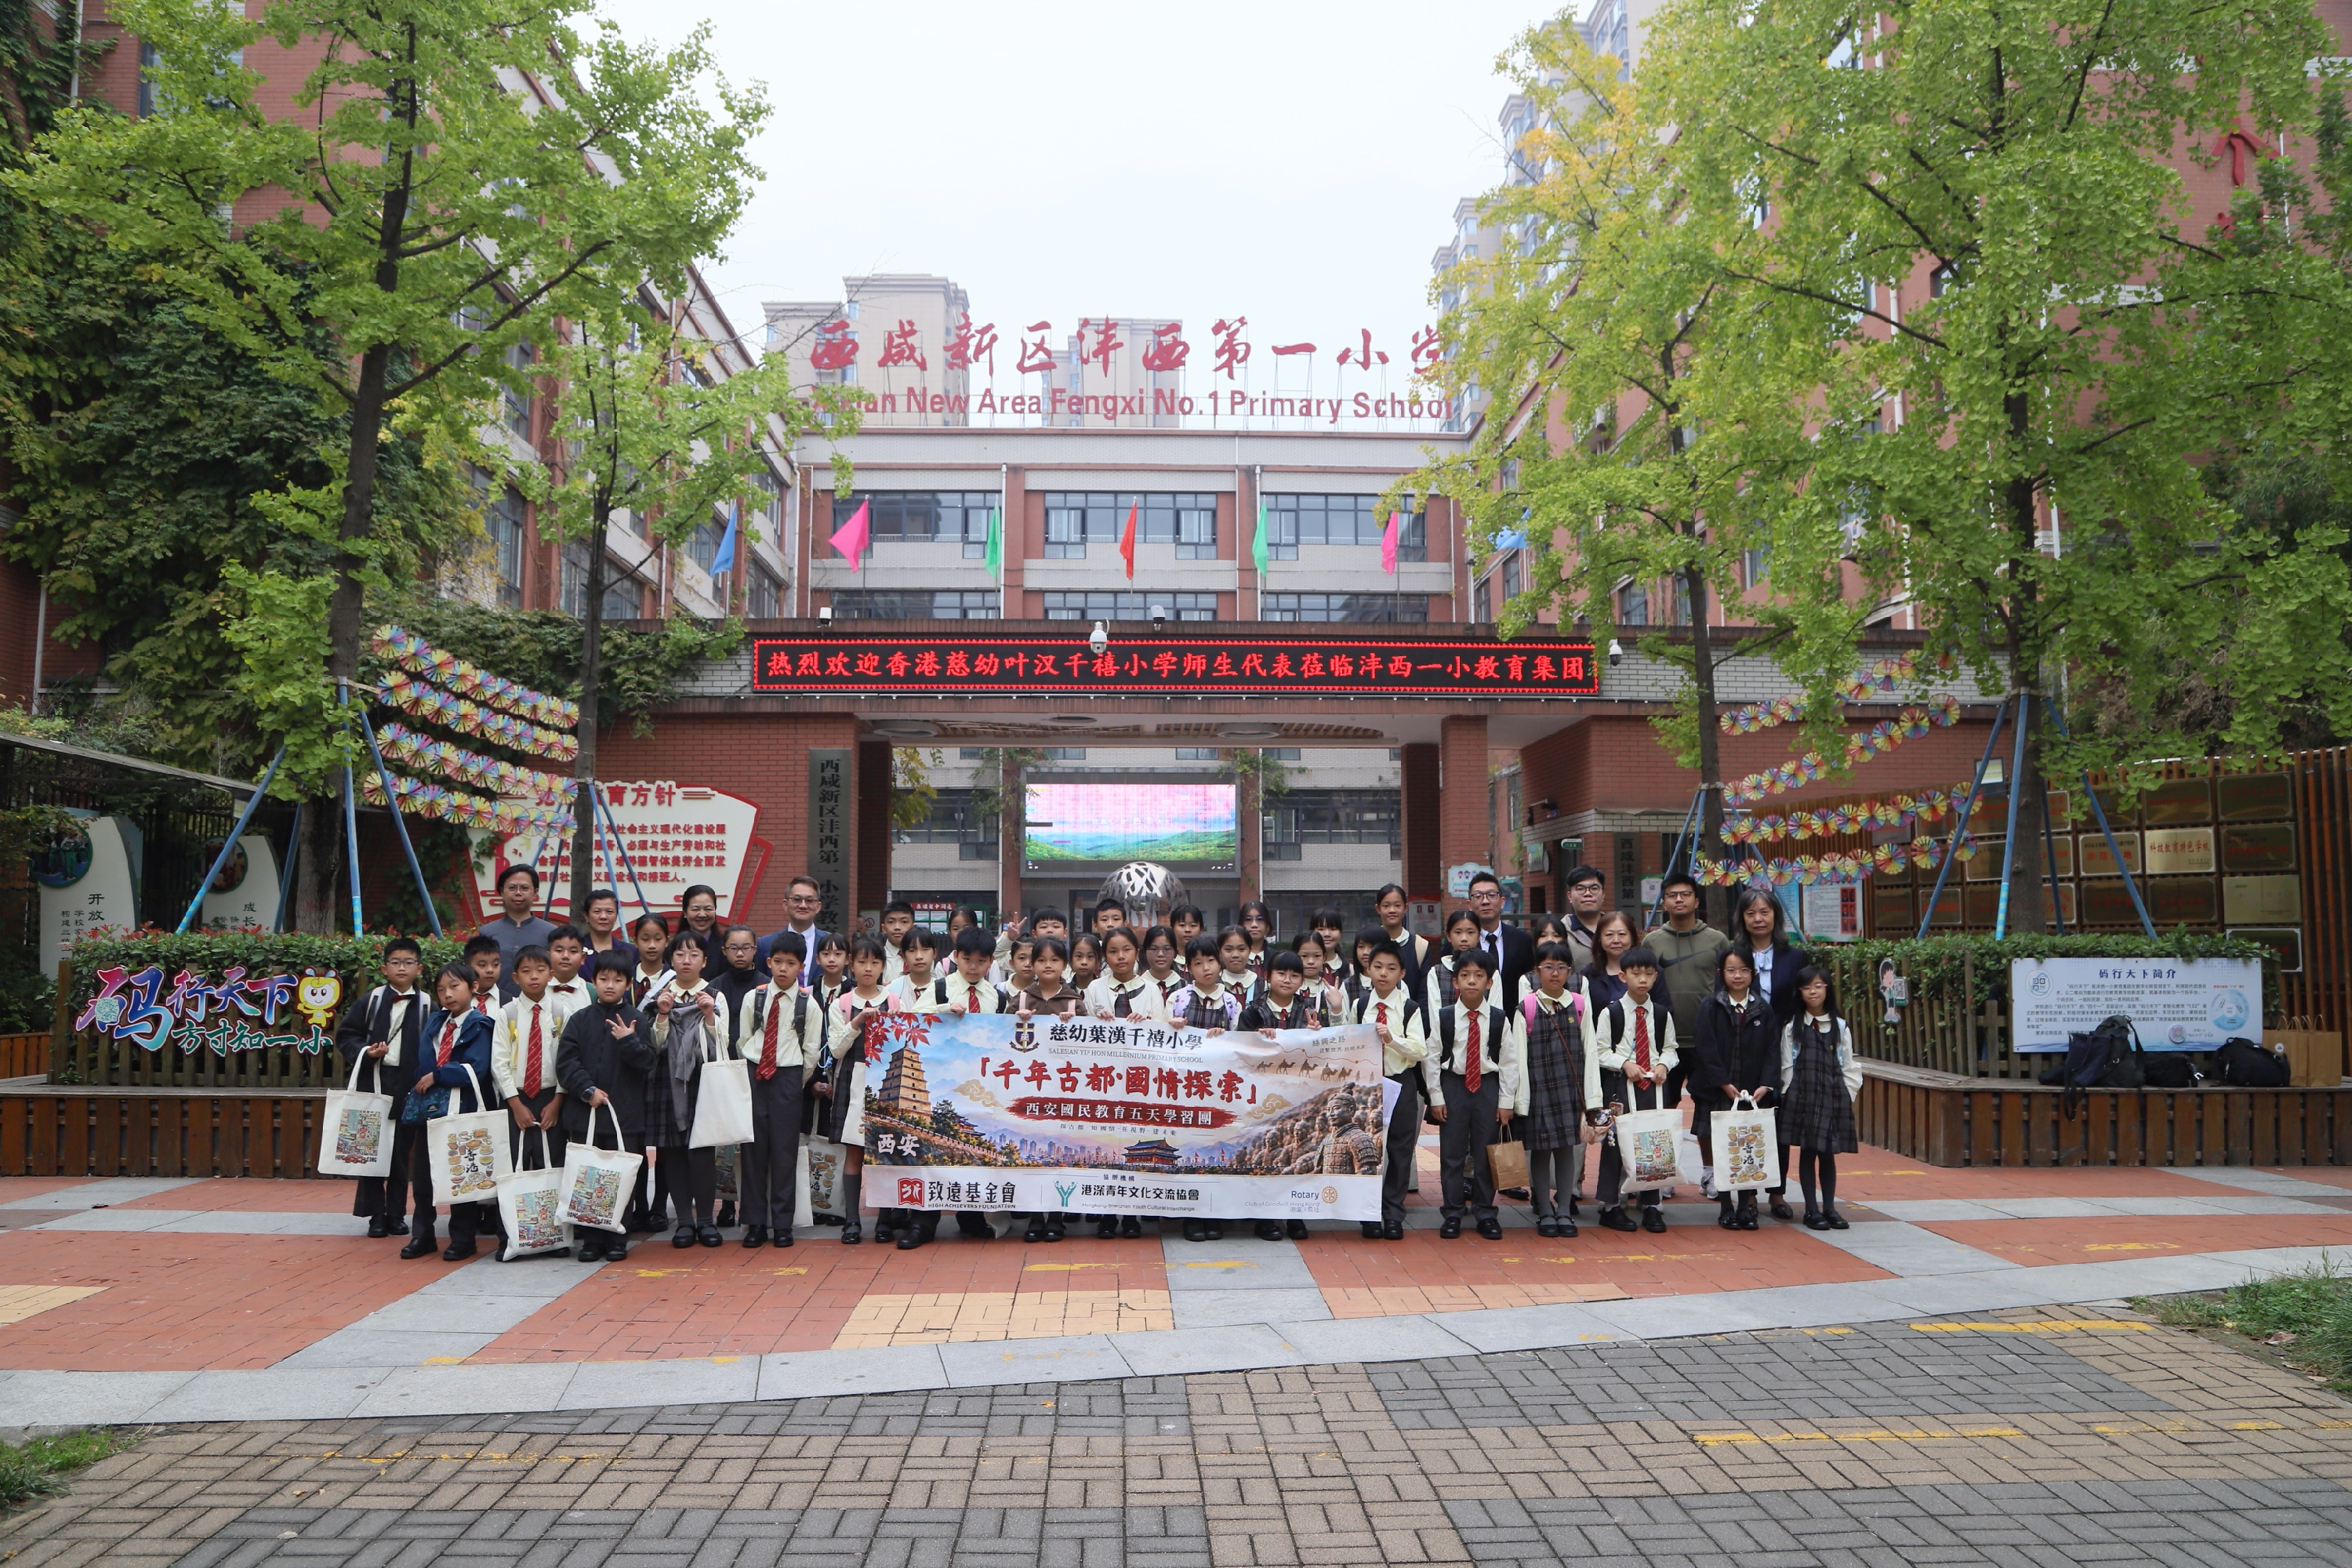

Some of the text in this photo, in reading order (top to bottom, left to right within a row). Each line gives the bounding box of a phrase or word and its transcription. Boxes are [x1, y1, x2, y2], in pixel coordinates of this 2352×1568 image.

[907, 387, 969, 412] New
[978, 388, 1041, 414] Area
[1052, 388, 1144, 420] Fengxi
[1155, 388, 1218, 415] No.1
[1231, 390, 1342, 424] Primary
[1354, 392, 1452, 419] School
[767, 651, 1584, 681] 热烈欢迎香港慈幼叶汉千禧小学师生代表莅临沣西一小教育集团
[2086, 851, 2132, 861] 示范地
[2149, 840, 2210, 854] 科技教育特色学校
[242, 902, 256, 927] 成长
[2099, 968, 2177, 979] 码行天下简介
[76, 965, 298, 1051] 码行天下
[171, 1018, 334, 1058] 方寸知一小
[1049, 1023, 1203, 1051] 慈幼葉漢千禧小學
[1106, 1051, 1147, 1060] MILLENNIUM
[1148, 1053, 1177, 1062] PRIMARY
[1025, 1102, 1213, 1126] 西安國民教育五天學習團
[877, 1133, 920, 1158] 西安
[1742, 1142, 1755, 1165] 香港
[463, 1149, 479, 1174] 香港
[928, 1181, 1017, 1203] 致遠基金會
[1081, 1184, 1200, 1201] 港深青年文化交流協會
[1290, 1190, 1319, 1200] Rotary
